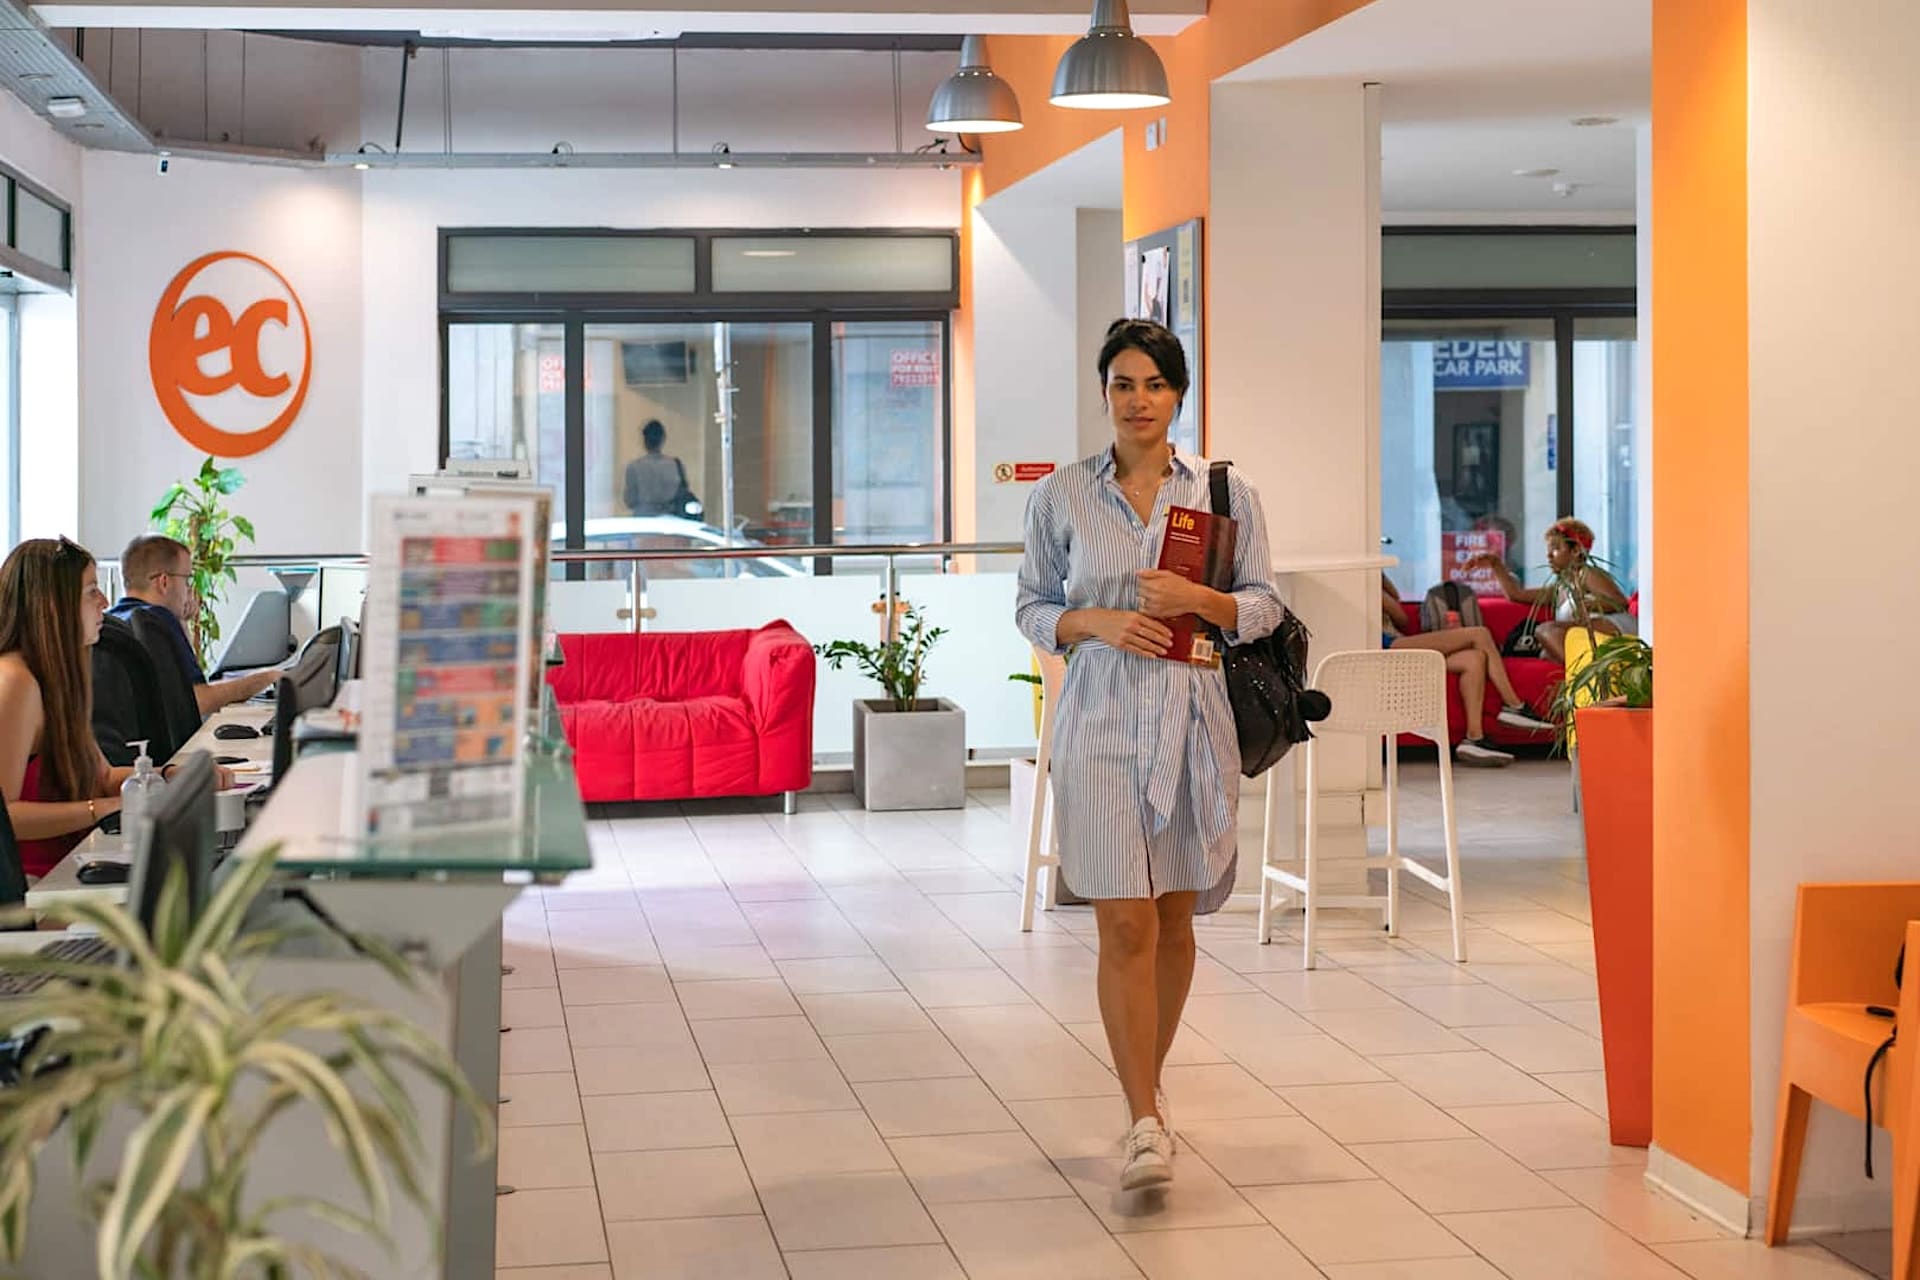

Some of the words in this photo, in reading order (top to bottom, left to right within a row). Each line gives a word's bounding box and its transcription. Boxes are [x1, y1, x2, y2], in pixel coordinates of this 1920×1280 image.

[1434, 340, 1522, 358] EDEN
[1434, 360, 1469, 376] CAR
[1474, 359, 1524, 375] PARK
[1172, 512, 1195, 531] Life
[1455, 533, 1487, 548] FIRE
